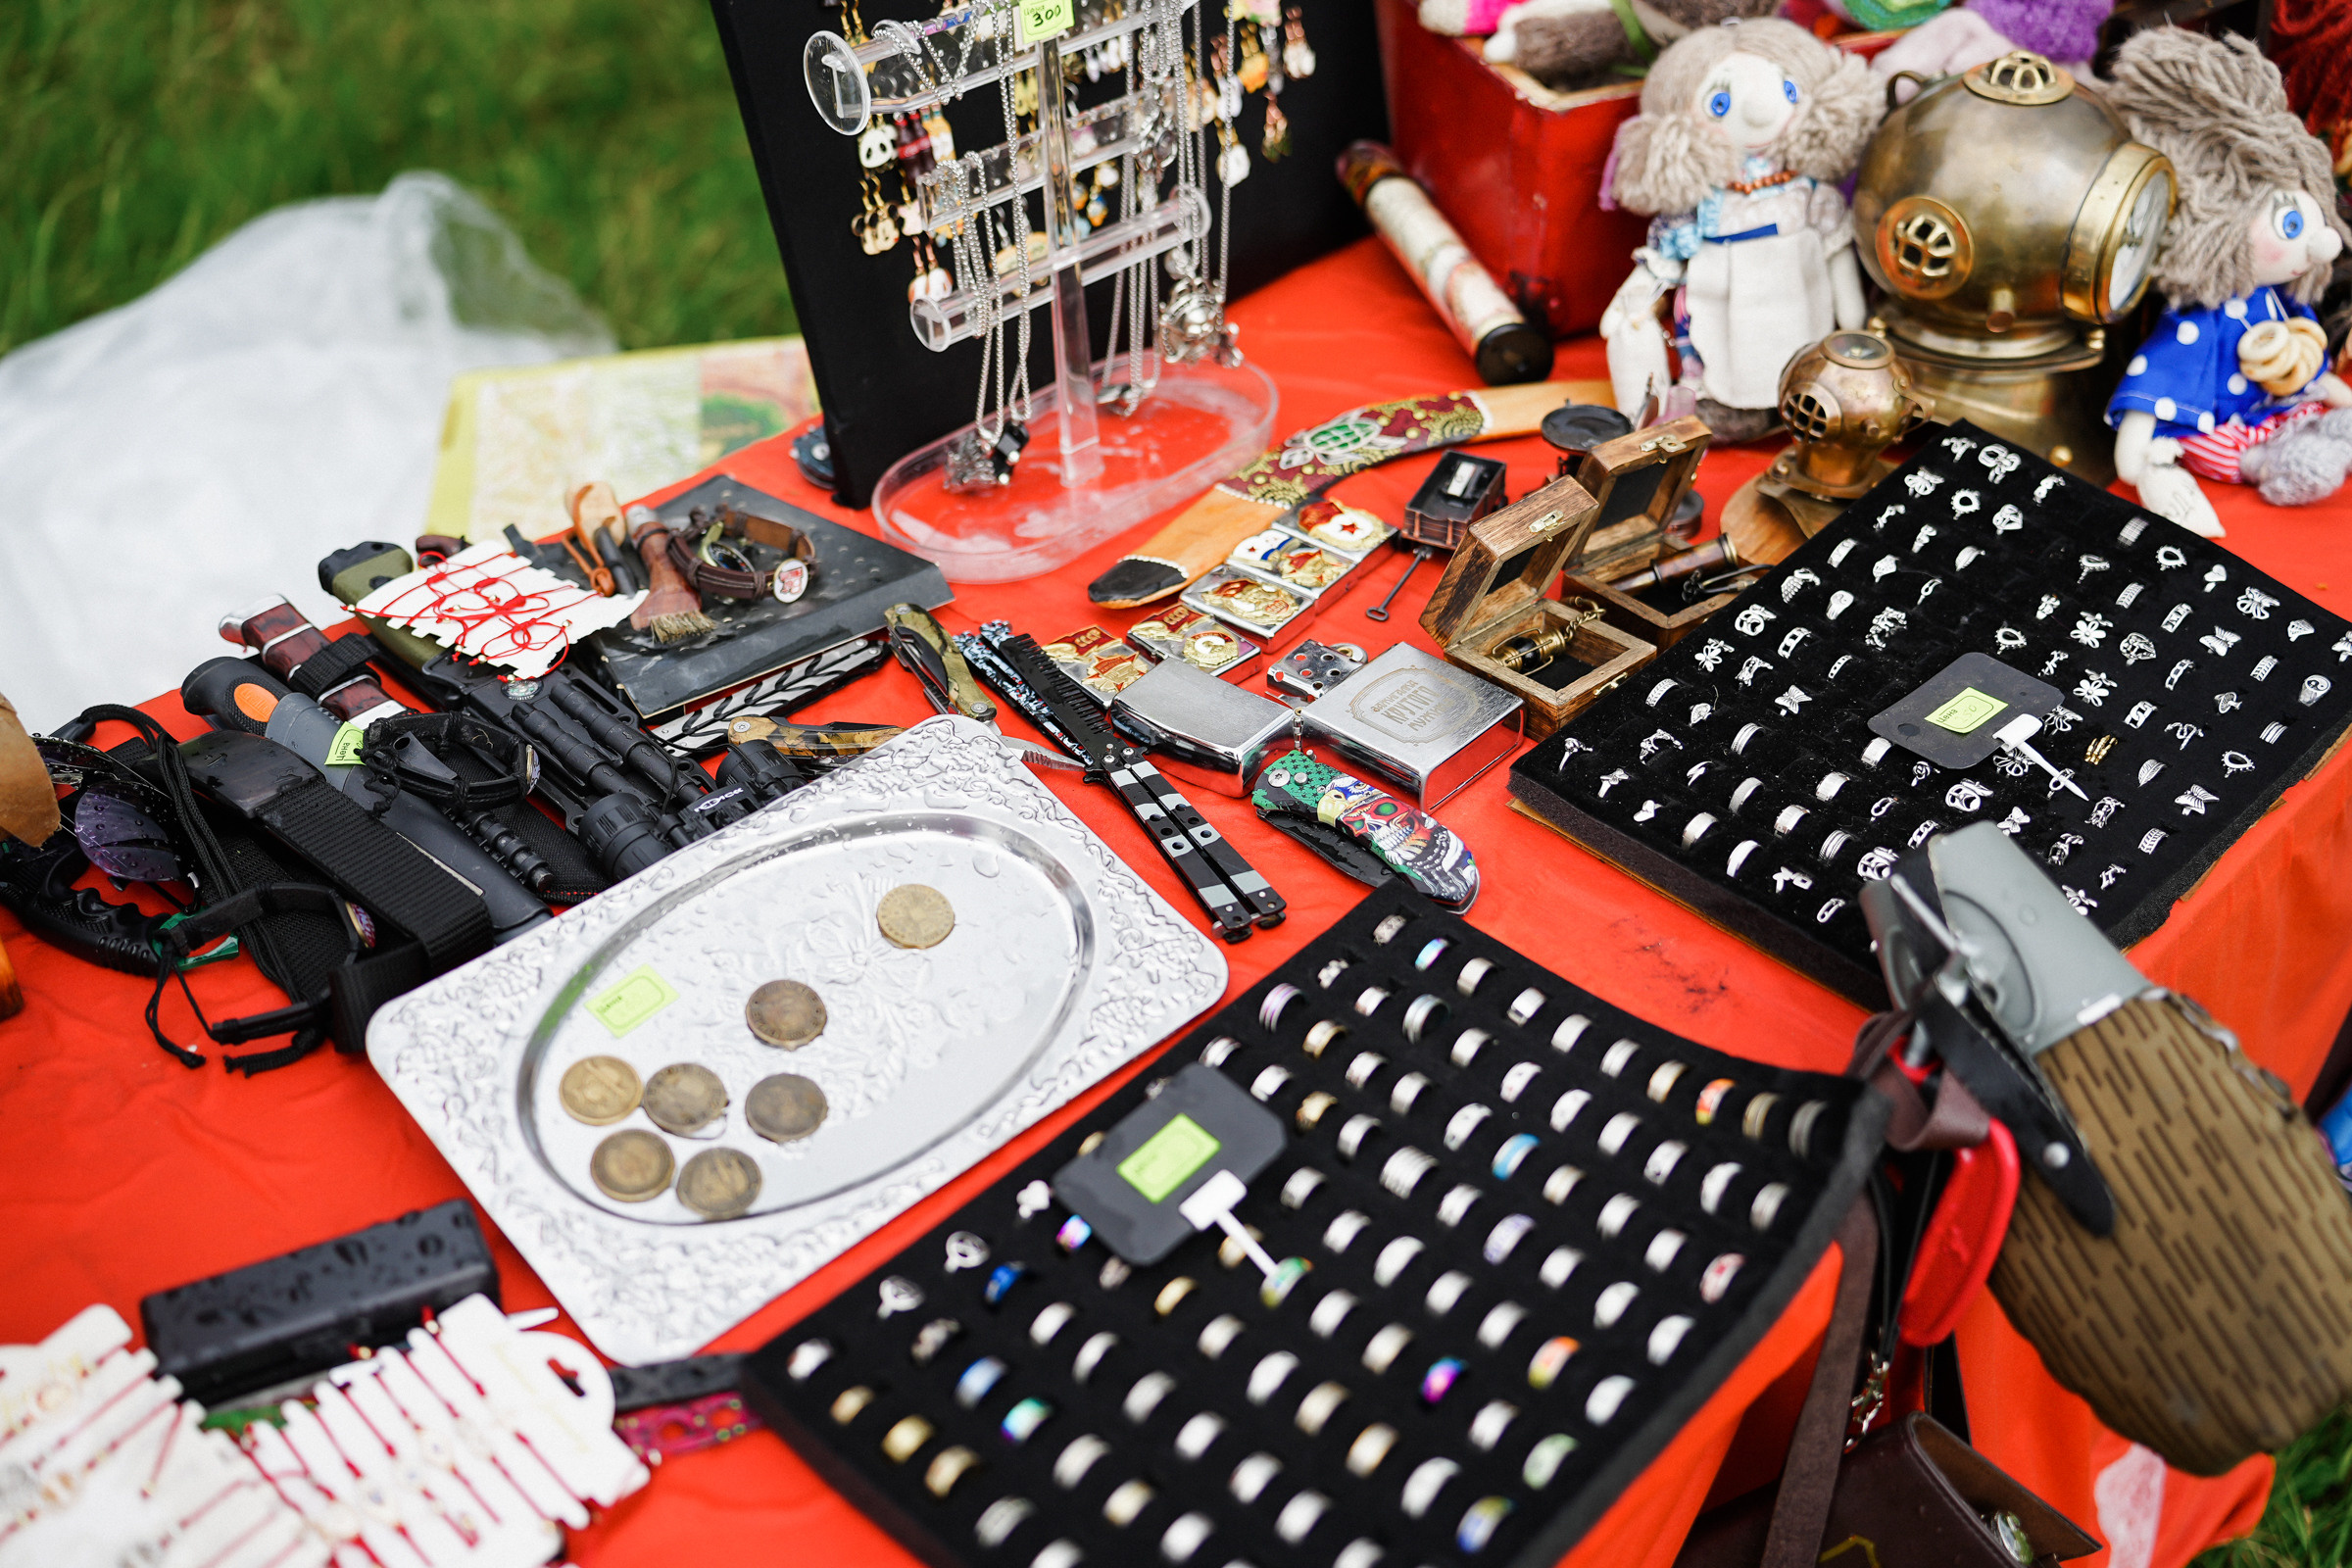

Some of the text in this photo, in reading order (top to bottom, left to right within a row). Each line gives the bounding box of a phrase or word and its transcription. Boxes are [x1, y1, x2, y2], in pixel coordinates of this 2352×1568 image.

[1032, 5, 1061, 27] 300
[1163, 606, 1189, 625] СССР
[1074, 628, 1102, 647] СССР
[1381, 685, 1442, 725] КРУТОГО
[1936, 709, 1958, 723] Цена
[335, 742, 351, 761] Цена
